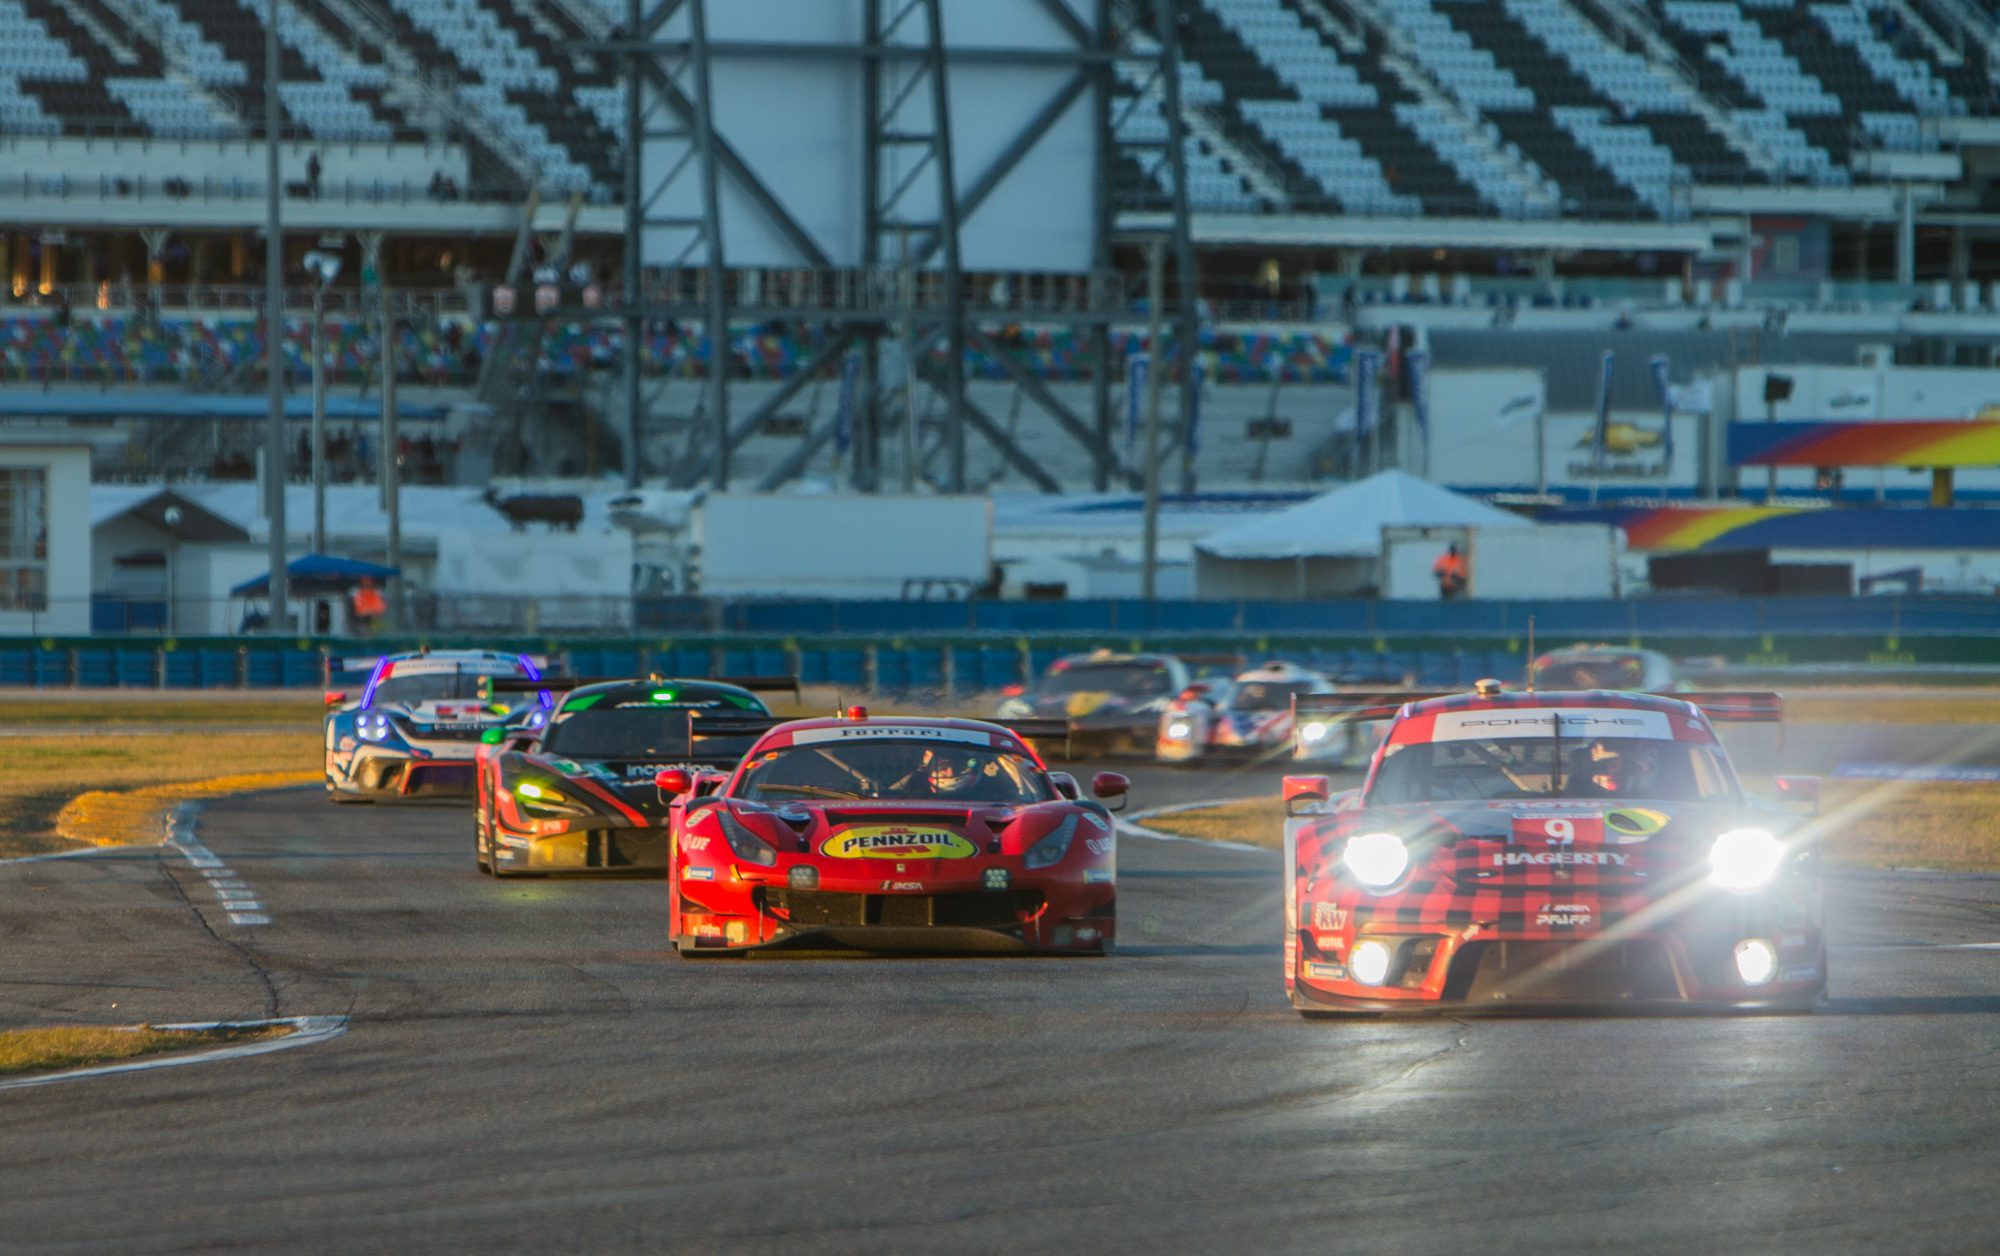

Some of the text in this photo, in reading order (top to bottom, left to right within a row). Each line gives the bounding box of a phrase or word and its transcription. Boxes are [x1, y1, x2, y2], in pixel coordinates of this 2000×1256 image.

[1461, 717, 1645, 728] PORSCHE
[841, 728, 944, 738] Ferrari
[1544, 818, 1575, 845] 9
[843, 833, 955, 854] PENNZOIL
[1493, 853, 1627, 866] HAGERTY
